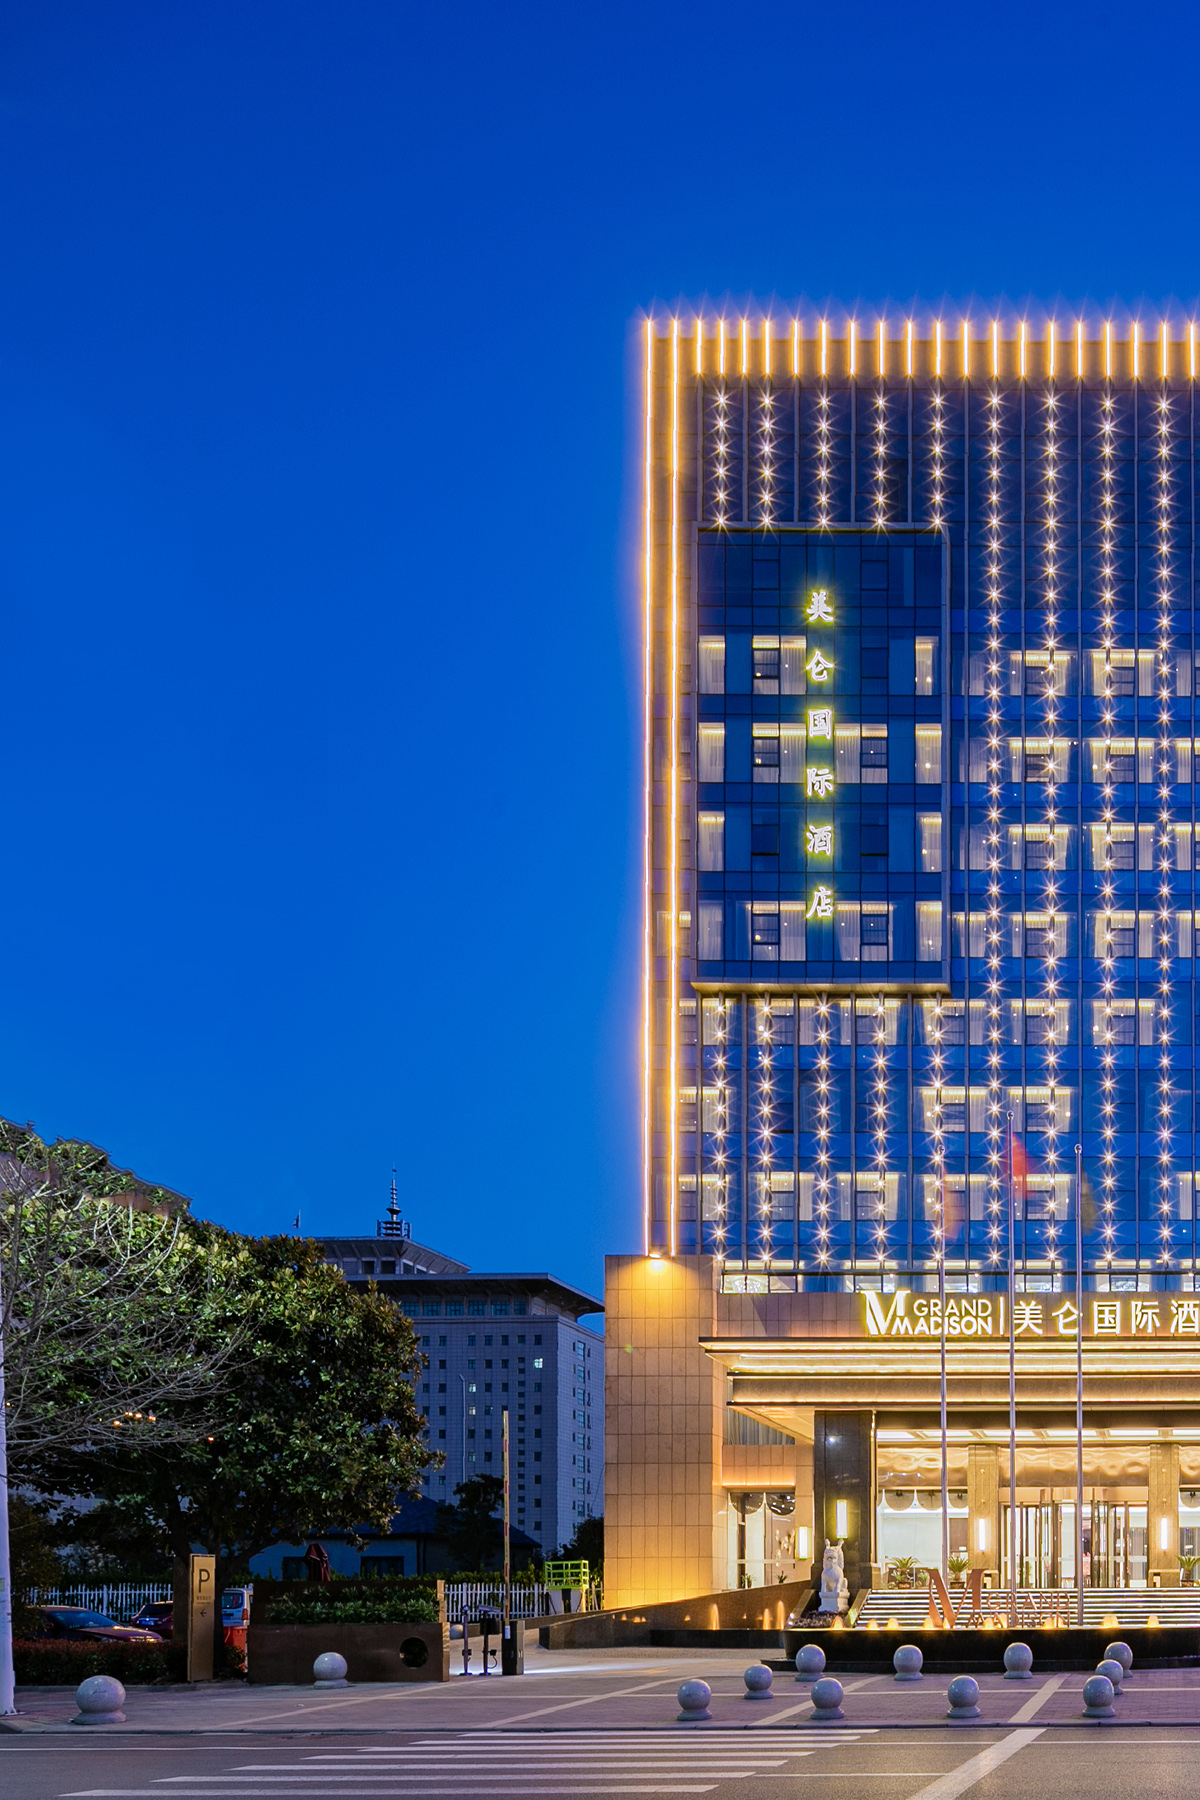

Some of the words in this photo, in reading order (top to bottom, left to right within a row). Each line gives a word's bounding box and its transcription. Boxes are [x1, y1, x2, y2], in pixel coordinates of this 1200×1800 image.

[806, 590, 835, 920] 美仑国际酒店
[913, 1299, 993, 1316] GRAND
[891, 1316, 993, 1336] MADISON
[199, 1569, 210, 1593] P
[986, 1592, 1071, 1611] GRAND
[965, 1611, 1071, 1628] MADISON
